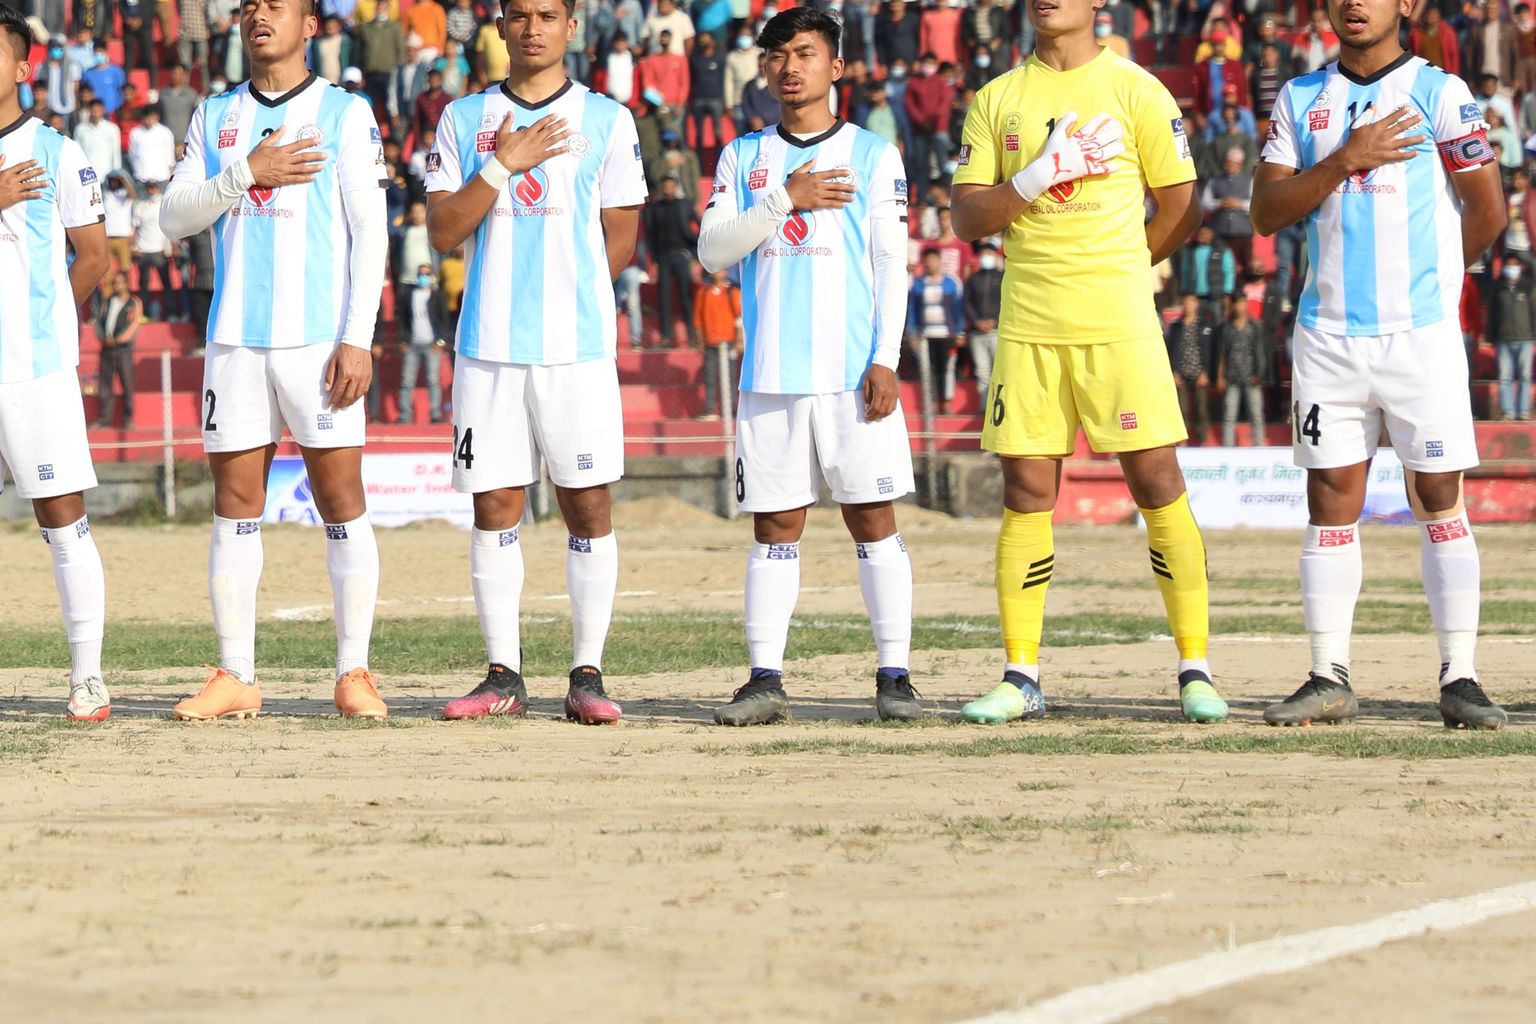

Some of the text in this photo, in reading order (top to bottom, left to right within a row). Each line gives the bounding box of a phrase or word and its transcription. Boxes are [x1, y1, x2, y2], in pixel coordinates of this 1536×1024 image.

[1309, 110, 1330, 120] KTM
[1309, 121, 1329, 131] CTY
[219, 128, 238, 139] KTM
[477, 131, 497, 141] KTM
[218, 139, 236, 149] CTY
[477, 142, 496, 152] CTY
[1461, 139, 1484, 160] C
[749, 169, 768, 179] KTM
[748, 179, 767, 190] CTY
[1352, 184, 1397, 194] CORPORATION
[243, 207, 294, 218] OIL CORPORATION
[494, 207, 564, 217] NEPAL OIL CORPORATION
[1045, 205, 1055, 215] OIL
[1055, 202, 1101, 214] CORPORATION
[779, 246, 789, 257] OIL
[790, 246, 833, 257] CORPORATION
[204, 388, 217, 431] 2
[317, 413, 333, 421] KTM
[1120, 413, 1136, 421] KTM
[318, 422, 333, 430] CTY
[1121, 422, 1137, 430] CTY
[1425, 440, 1443, 449] KTM
[1426, 449, 1444, 457] CTY
[38, 464, 53, 472] KTM
[578, 462, 593, 470] CTY
[39, 472, 55, 480] CTY
[877, 477, 893, 485] KTM
[878, 486, 894, 494] CTY
[1426, 518, 1463, 533] KTM
[1320, 528, 1354, 537] KTM
[1429, 526, 1469, 543] CTY
[1319, 536, 1354, 546] CTY
[768, 544, 798, 552] KTM
[767, 551, 798, 560] CTY
